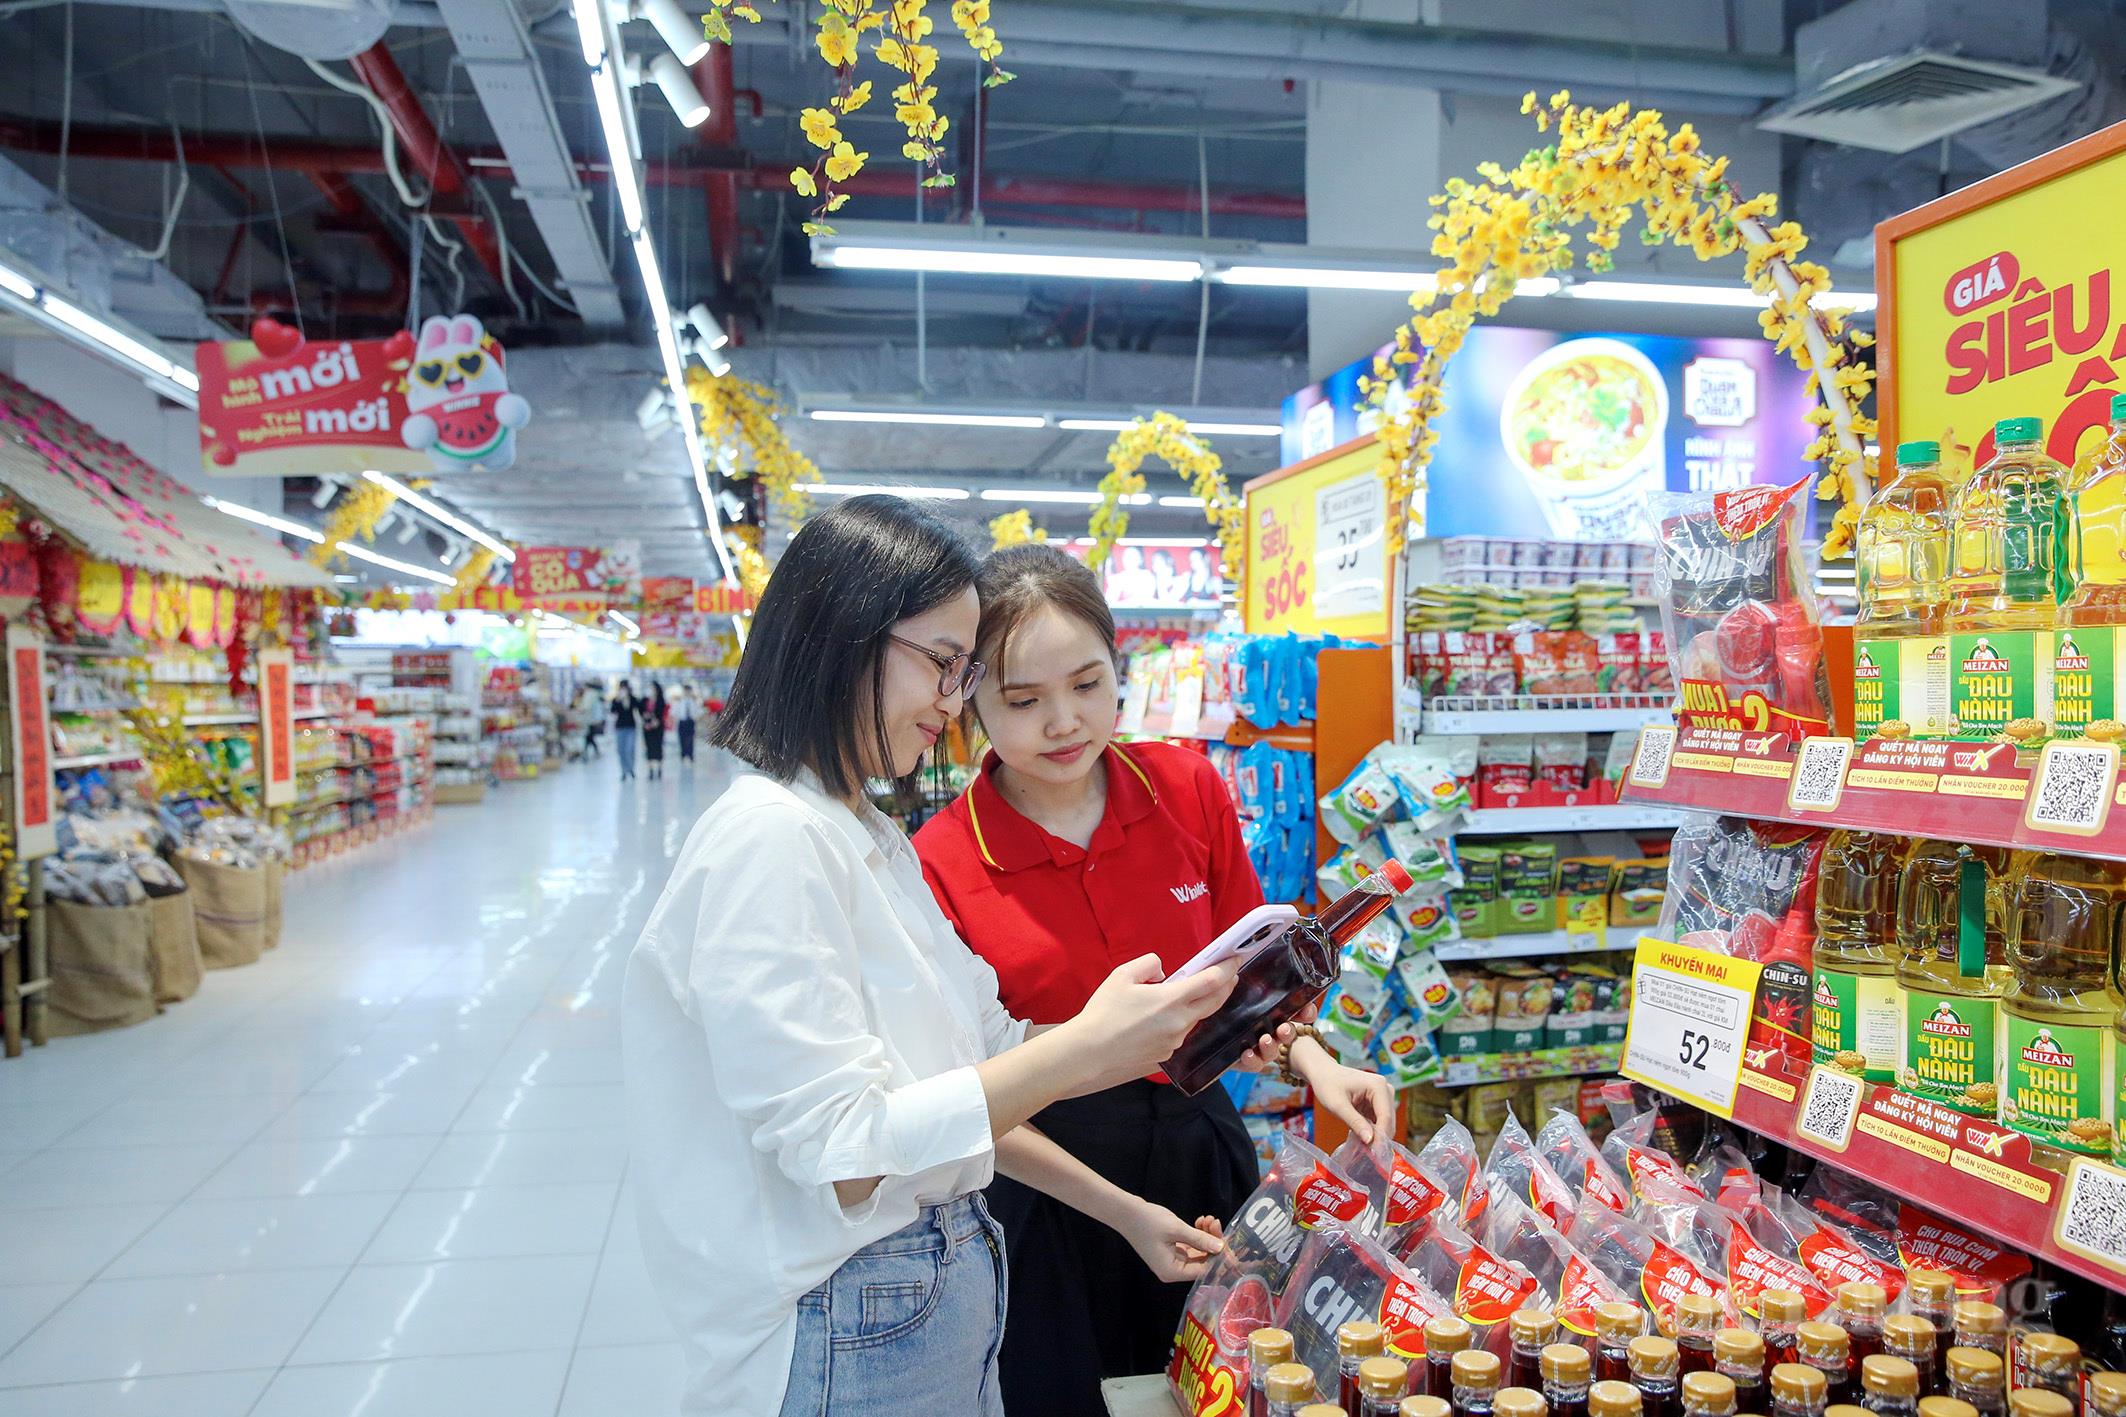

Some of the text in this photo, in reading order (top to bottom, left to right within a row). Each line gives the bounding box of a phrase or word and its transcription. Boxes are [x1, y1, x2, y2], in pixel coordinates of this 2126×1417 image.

[1952, 257, 2006, 308] GIÁ
[1945, 269, 2110, 395] SIÊU
[260, 341, 360, 400] mới
[306, 396, 391, 433] mới
[1963, 660, 2008, 671] MEIZAN
[1959, 697, 2012, 720] NÀNH
[1863, 752, 1946, 769] ĐĂNG KÝ HỘI VIÊN
[1879, 741, 1949, 756] QUÉT MÃ NGAY
[1964, 781, 1996, 790] VOUCHER
[1660, 951, 1728, 982] KHUYẾN MẠI
[1763, 968, 1808, 986] CHIN-SU
[1923, 1021, 1970, 1036] MEIZAN
[1679, 1029, 1710, 1071] 52
[2023, 1049, 2073, 1067] MEIZAN
[1917, 1056, 1974, 1083] NÀNH
[1890, 1093, 1916, 1110] QUÉT
[1917, 1102, 1932, 1117] MÃ
[1933, 1108, 1961, 1126] NGAY
[2017, 1086, 2078, 1119] NÀNH
[1873, 1100, 1958, 1140] ĐĂNG KÝ HỘI VIÊN
[1861, 1119, 1946, 1158] TÍCH 10 LẦN ĐIỂM THƯỞNG
[1955, 1154, 1975, 1168] NHẬN
[1976, 1162, 2010, 1180] VOUCHER
[2012, 1175, 2045, 1194] 20.000Đ
[1664, 1266, 1691, 1288] CHO
[1200, 1369, 1235, 1417] 2
